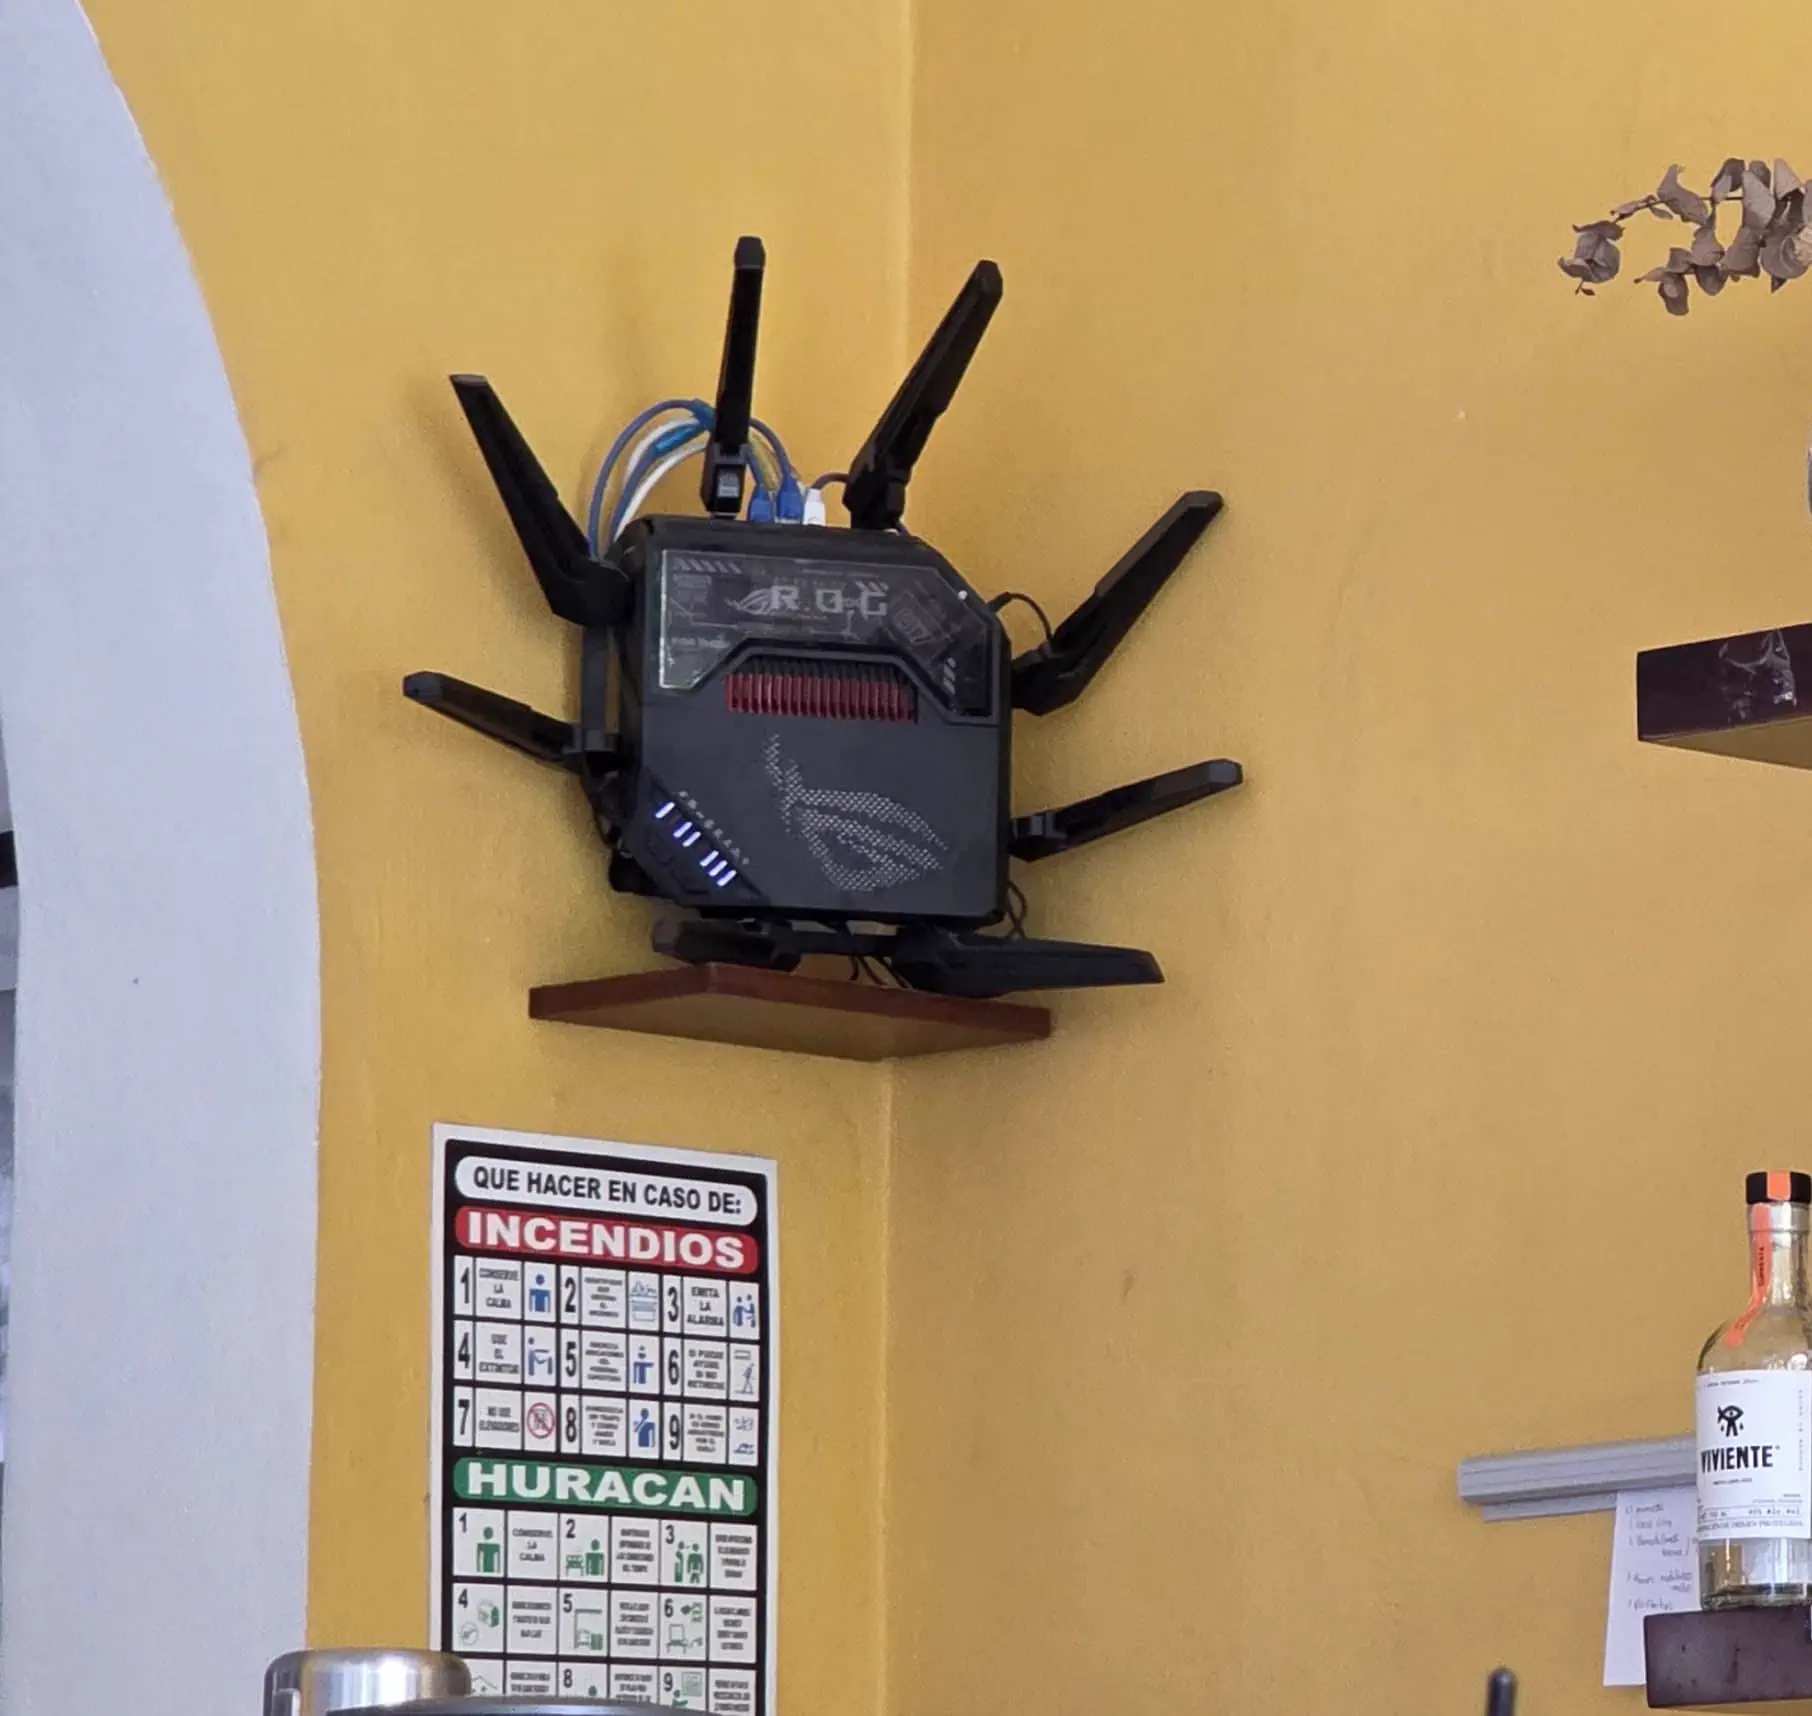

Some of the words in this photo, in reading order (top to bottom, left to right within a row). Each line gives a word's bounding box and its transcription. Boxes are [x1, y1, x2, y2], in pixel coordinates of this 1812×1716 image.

[473, 1166, 520, 1191] QUE
[527, 1171, 601, 1200] HACER
[608, 1179, 637, 1203] EN
[644, 1183, 701, 1209] CASO
[708, 1191, 742, 1214] DE:
[468, 1211, 745, 1269] INCENDIOS
[460, 1267, 470, 1305] 1
[564, 1276, 577, 1313] 2
[667, 1286, 680, 1323] 3
[687, 1314, 725, 1327] ALARMA
[458, 1332, 470, 1369] 4
[565, 1341, 577, 1378] 5
[667, 1349, 680, 1385] 6
[458, 1398, 470, 1436] 7
[565, 1406, 577, 1443] 8
[668, 1413, 681, 1451] 9
[1700, 1444, 1774, 1473] VIVIENTE
[467, 1461, 745, 1512] HURACAN
[459, 1511, 468, 1534] 1
[565, 1518, 576, 1539] 2
[665, 1524, 675, 1544] 3
[458, 1588, 468, 1609] 4
[563, 1592, 573, 1613] 5
[664, 1598, 674, 1618] 6
[563, 1667, 573, 1688] 8
[663, 1672, 674, 1692] 9
